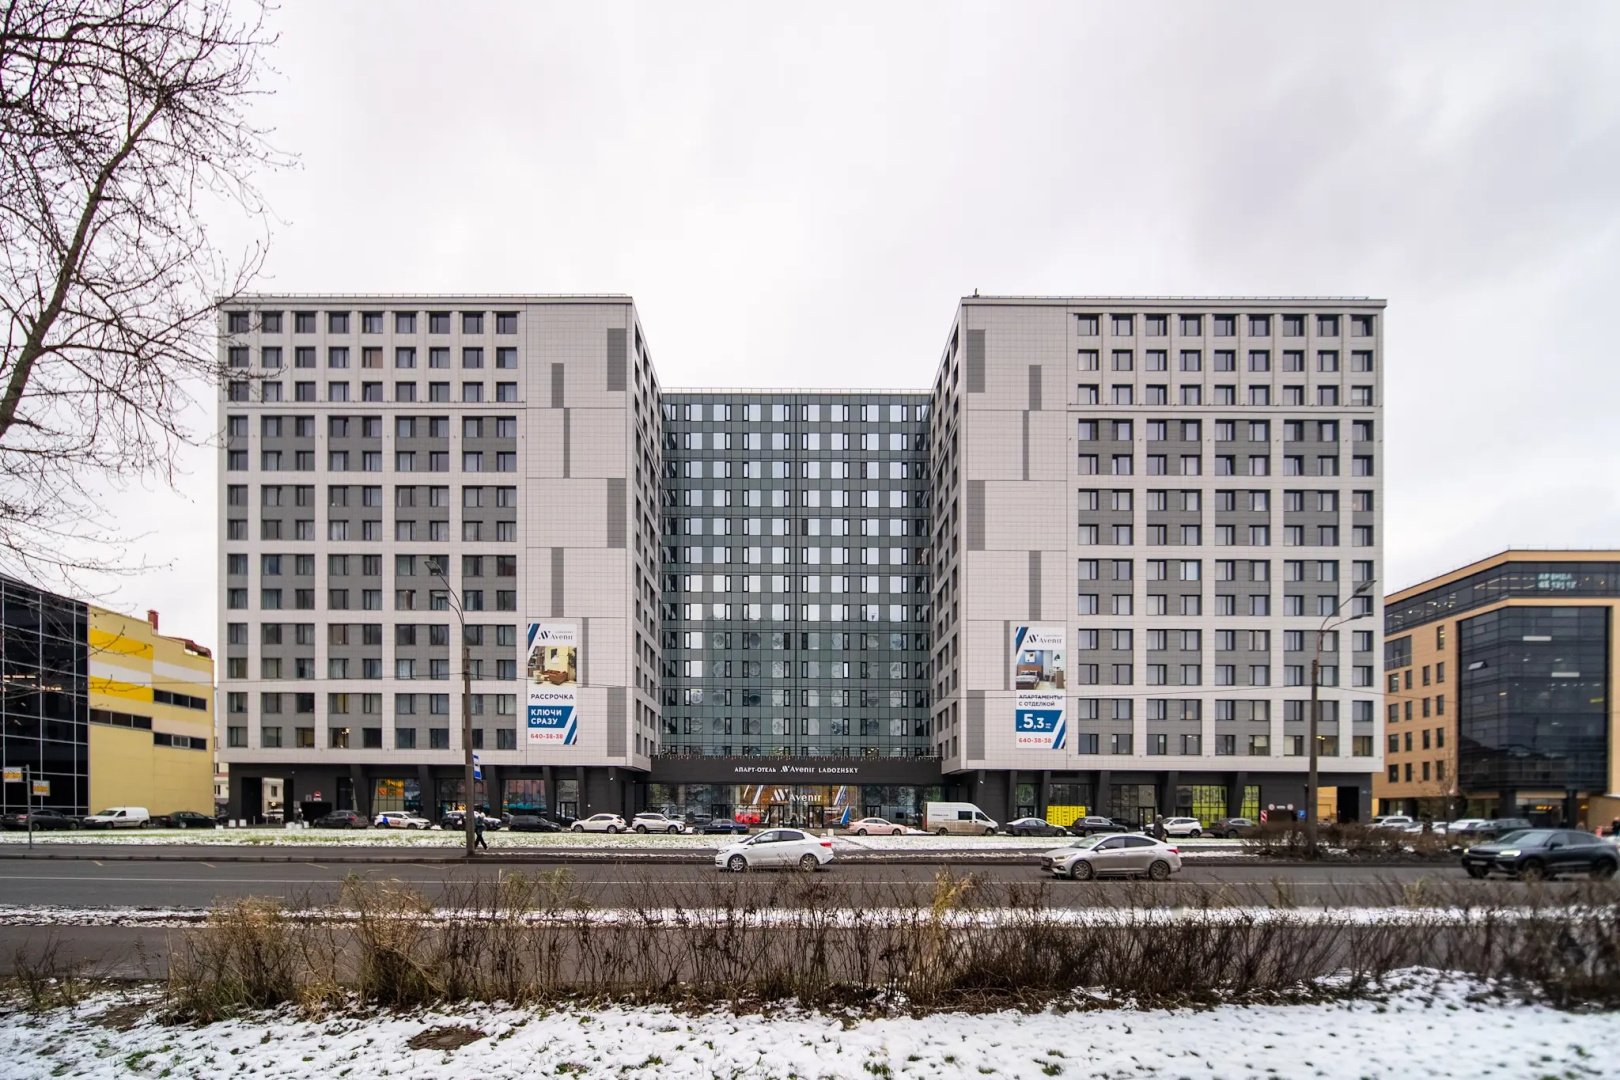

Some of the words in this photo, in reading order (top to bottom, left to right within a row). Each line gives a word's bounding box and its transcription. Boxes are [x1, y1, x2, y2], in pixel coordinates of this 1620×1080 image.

[1023, 713, 1045, 729] 5,3
[789, 765, 815, 773] Avenir
[789, 793, 822, 802] Avenir
